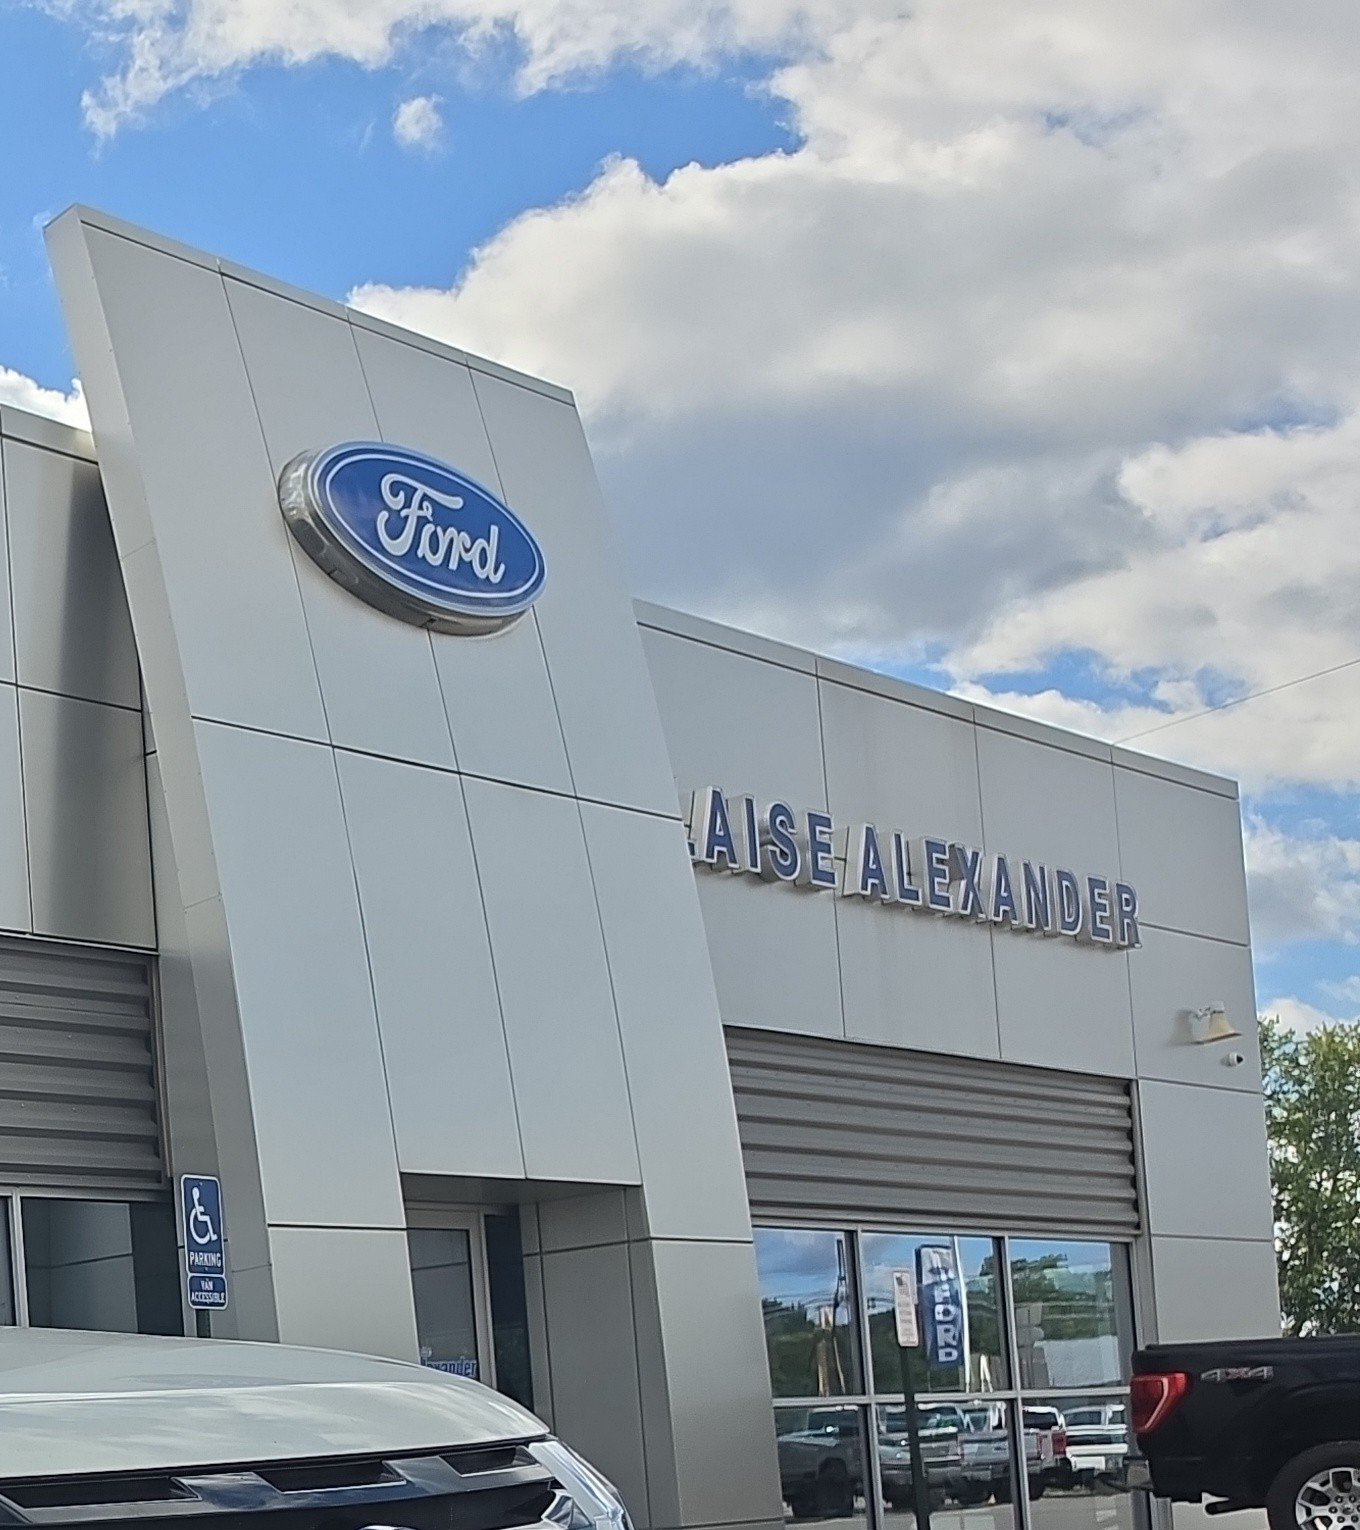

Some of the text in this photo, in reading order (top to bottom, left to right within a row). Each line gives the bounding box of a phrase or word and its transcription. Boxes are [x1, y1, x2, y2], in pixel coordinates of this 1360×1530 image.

[376, 472, 506, 584] Ford
[856, 821, 1143, 949] ALEXANDER
[189, 1251, 222, 1267] PARKING
[200, 1280, 214, 1291] VAN
